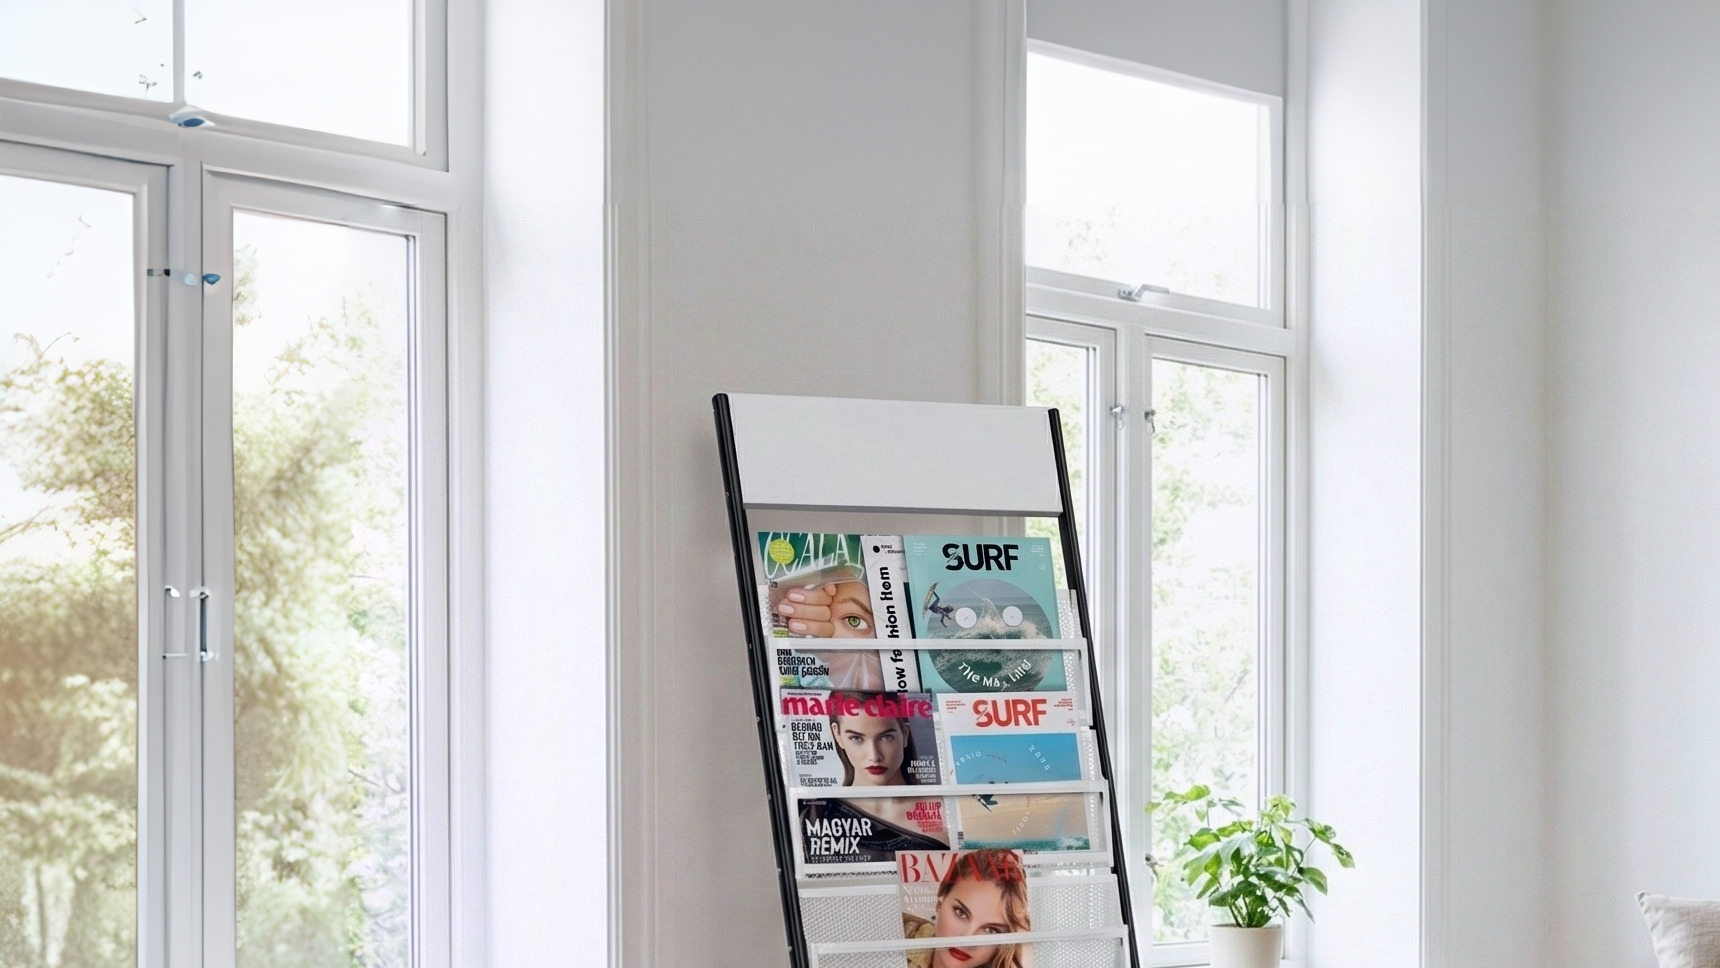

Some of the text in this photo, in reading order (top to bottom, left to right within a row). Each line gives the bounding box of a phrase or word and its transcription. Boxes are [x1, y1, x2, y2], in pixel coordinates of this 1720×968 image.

[942, 543, 1019, 571] SURF
[781, 690, 934, 719] marie claire
[972, 698, 1047, 728] SURF
[804, 818, 873, 838] MAGYAR
[810, 836, 860, 856] REMIX
